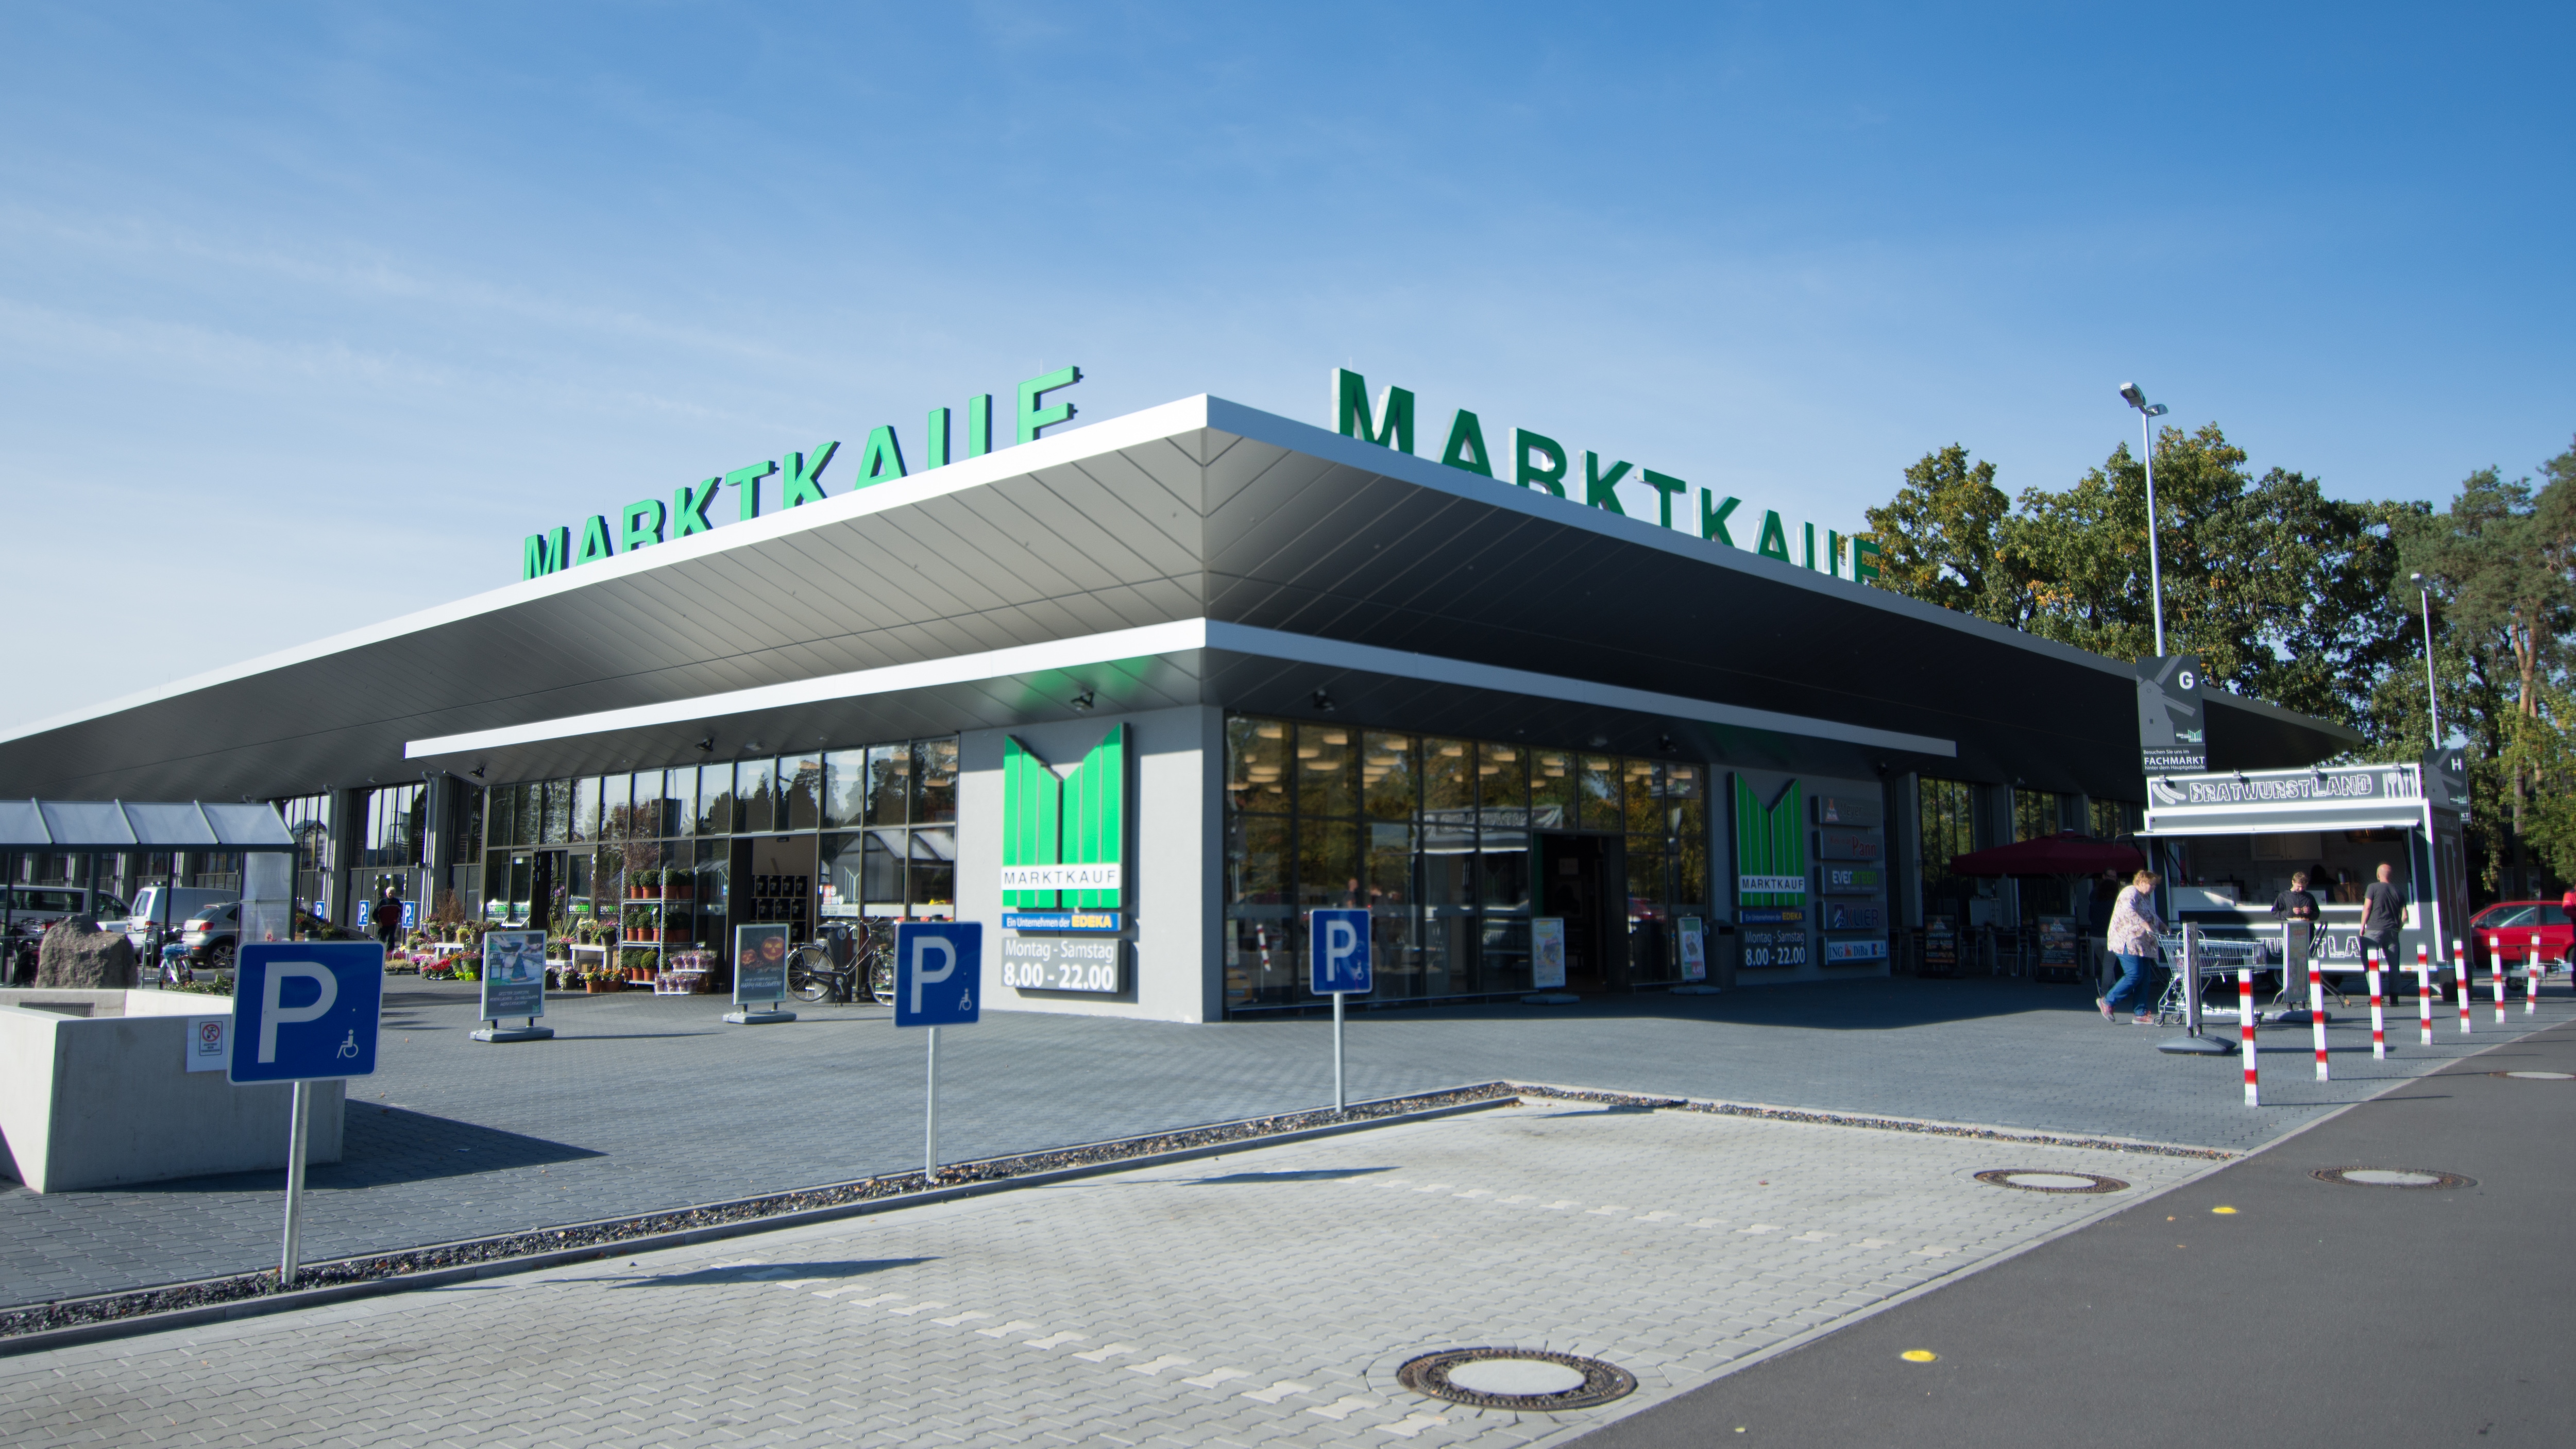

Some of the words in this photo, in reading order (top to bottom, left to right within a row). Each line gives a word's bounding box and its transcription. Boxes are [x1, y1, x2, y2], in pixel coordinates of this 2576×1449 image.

[523, 365, 1084, 581] MARKTKAUF
[1331, 367, 1880, 583] MARKTKAUF
[2179, 672, 2194, 689] G
[2144, 756, 2205, 765] FACHMARKT
[2451, 758, 2462, 771] H
[1852, 836, 1876, 857] Pann
[1004, 870, 1116, 885] MARKTKAUF
[1742, 879, 1804, 889] MARKTKAUF
[1006, 917, 1016, 927] Ein
[1016, 916, 1058, 927] Unternehmen
[1059, 917, 1070, 927] der
[1071, 915, 1112, 928] EDEKA
[1782, 912, 1803, 920] EDEKA
[1846, 908, 1879, 927] KLIER
[1745, 930, 1772, 946] Montag
[1777, 930, 1805, 945] Samstag
[1005, 940, 1050, 962] Montag
[1060, 940, 1114, 964] Samstag
[1326, 920, 1357, 982] P
[1745, 948, 1769, 966] 8.00
[1777, 946, 1805, 965] 22.00
[1829, 946, 1843, 958] ING
[1854, 945, 1868, 956] DiBa
[910, 936, 956, 1014] P
[1004, 962, 1044, 987] 8.00
[1058, 964, 1114, 991] 22.00
[258, 961, 338, 1063] P
